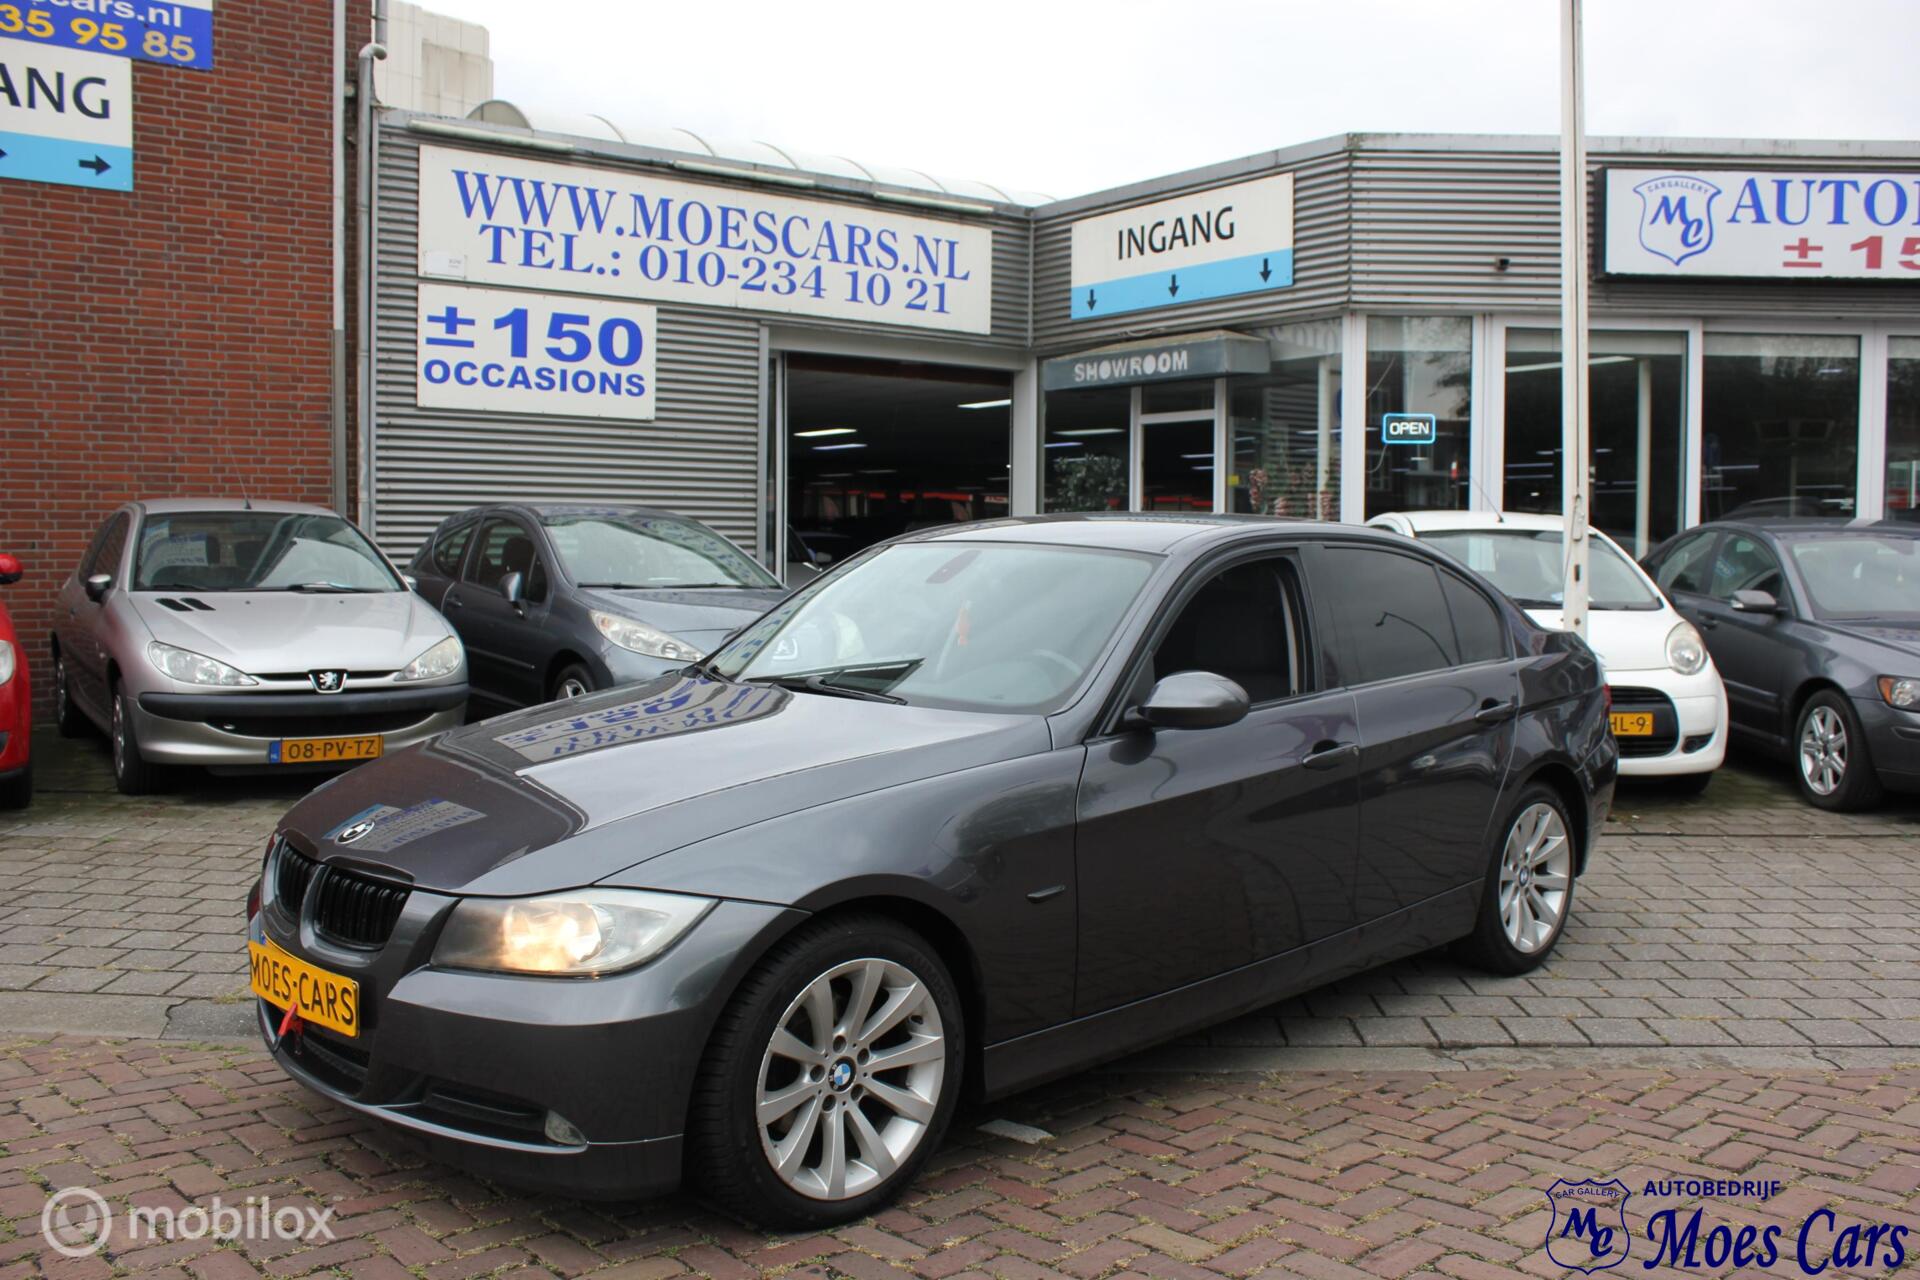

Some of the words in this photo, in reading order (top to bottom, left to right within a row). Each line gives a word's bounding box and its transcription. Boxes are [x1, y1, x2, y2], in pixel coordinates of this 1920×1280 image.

[70, 17, 128, 51] 95
[142, 30, 196, 62] 85
[451, 169, 970, 281] WWW.MOESCARS.NL
[1726, 177, 1920, 226] AUTO
[1117, 205, 1235, 261] INGANG
[478, 223, 621, 277] TEL.:
[639, 244, 827, 300] 010-234
[844, 270, 891, 306] 10
[904, 278, 951, 314] 21
[424, 359, 646, 398] OCCASIONS
[1074, 349, 1188, 382] SHOWROOM
[1389, 420, 1430, 437] OPEN
[288, 739, 376, 760] 08-PV-TZ
[249, 949, 355, 1026] MOES-CARS
